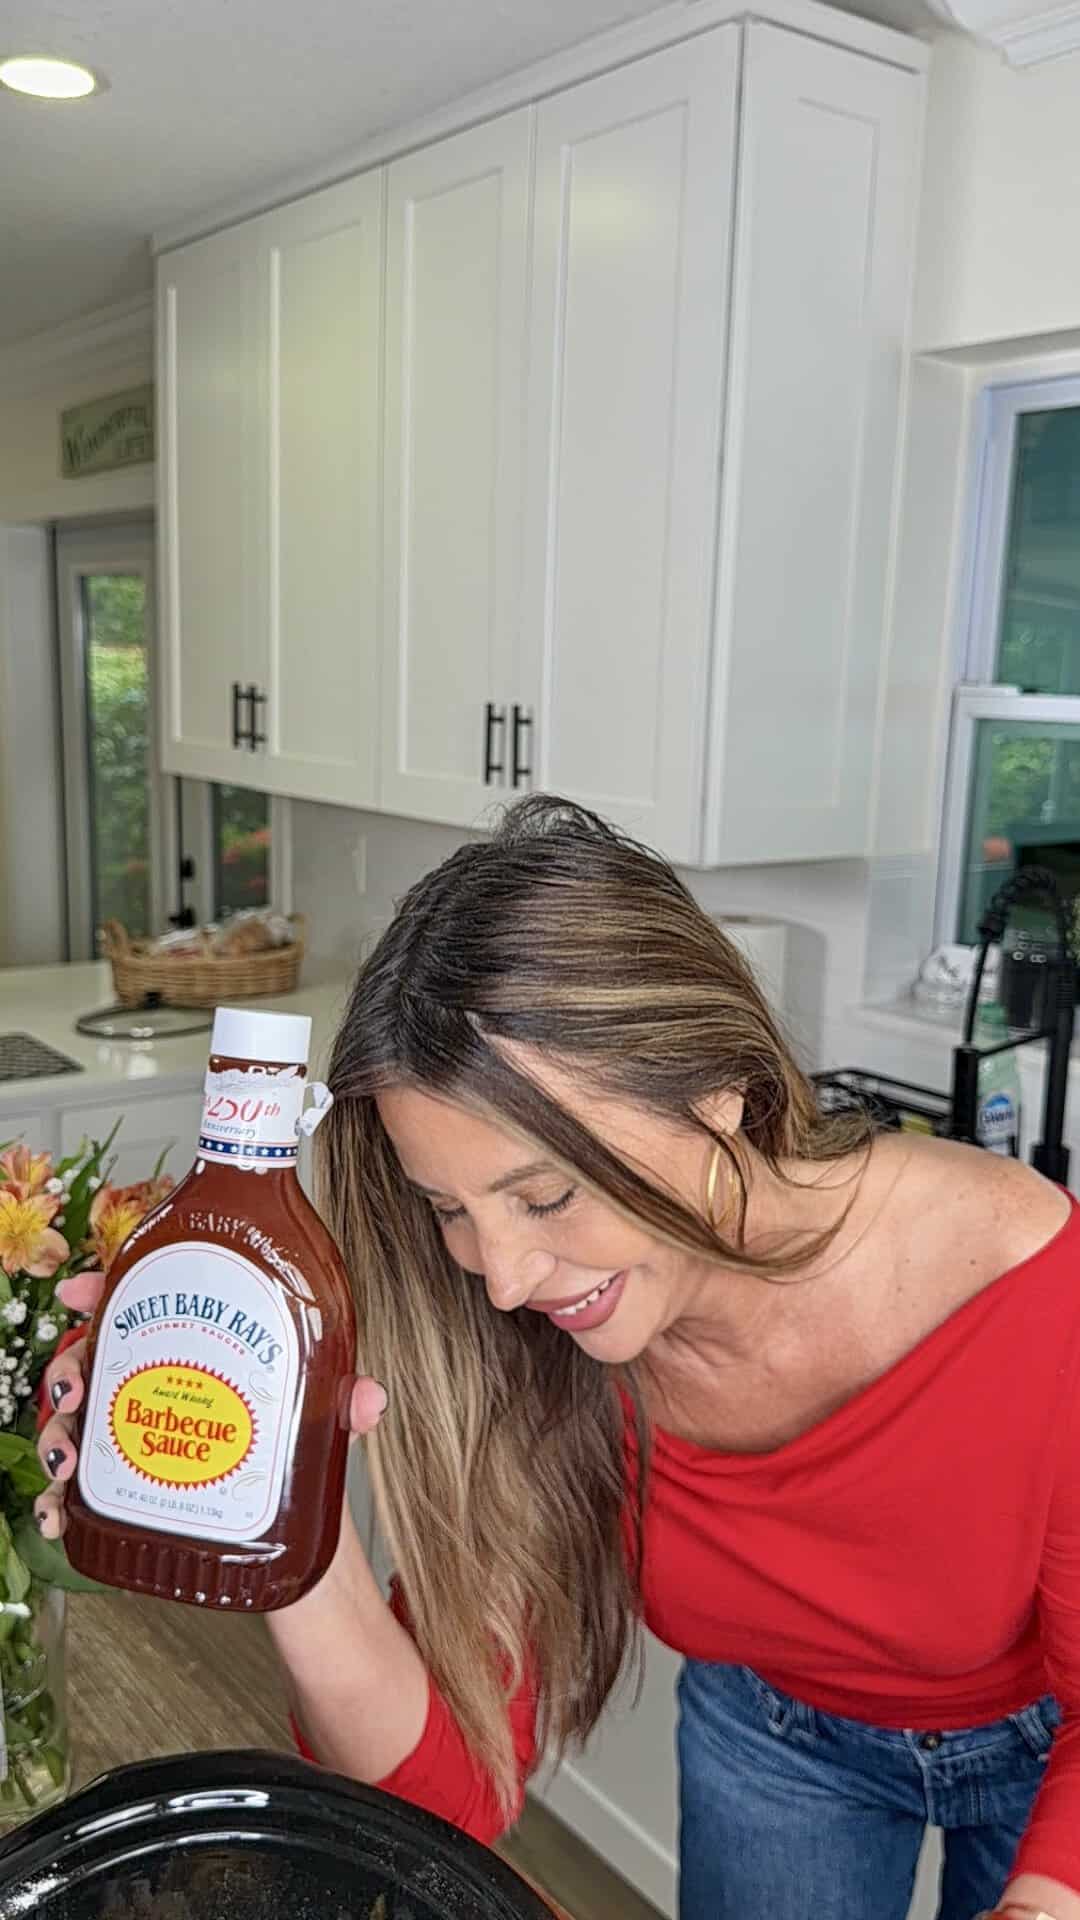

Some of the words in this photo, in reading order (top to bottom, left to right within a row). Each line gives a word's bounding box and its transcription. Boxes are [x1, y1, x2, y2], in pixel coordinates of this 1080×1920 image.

[113, 1293, 170, 1341] SWEET
[175, 1293, 230, 1325] BABY
[227, 1309, 284, 1366] RAY'S
[140, 1321, 196, 1338] GOURMET
[201, 1326, 247, 1356] SAUCES
[125, 1398, 237, 1443] Barbecue
[140, 1431, 211, 1462] Sauce
